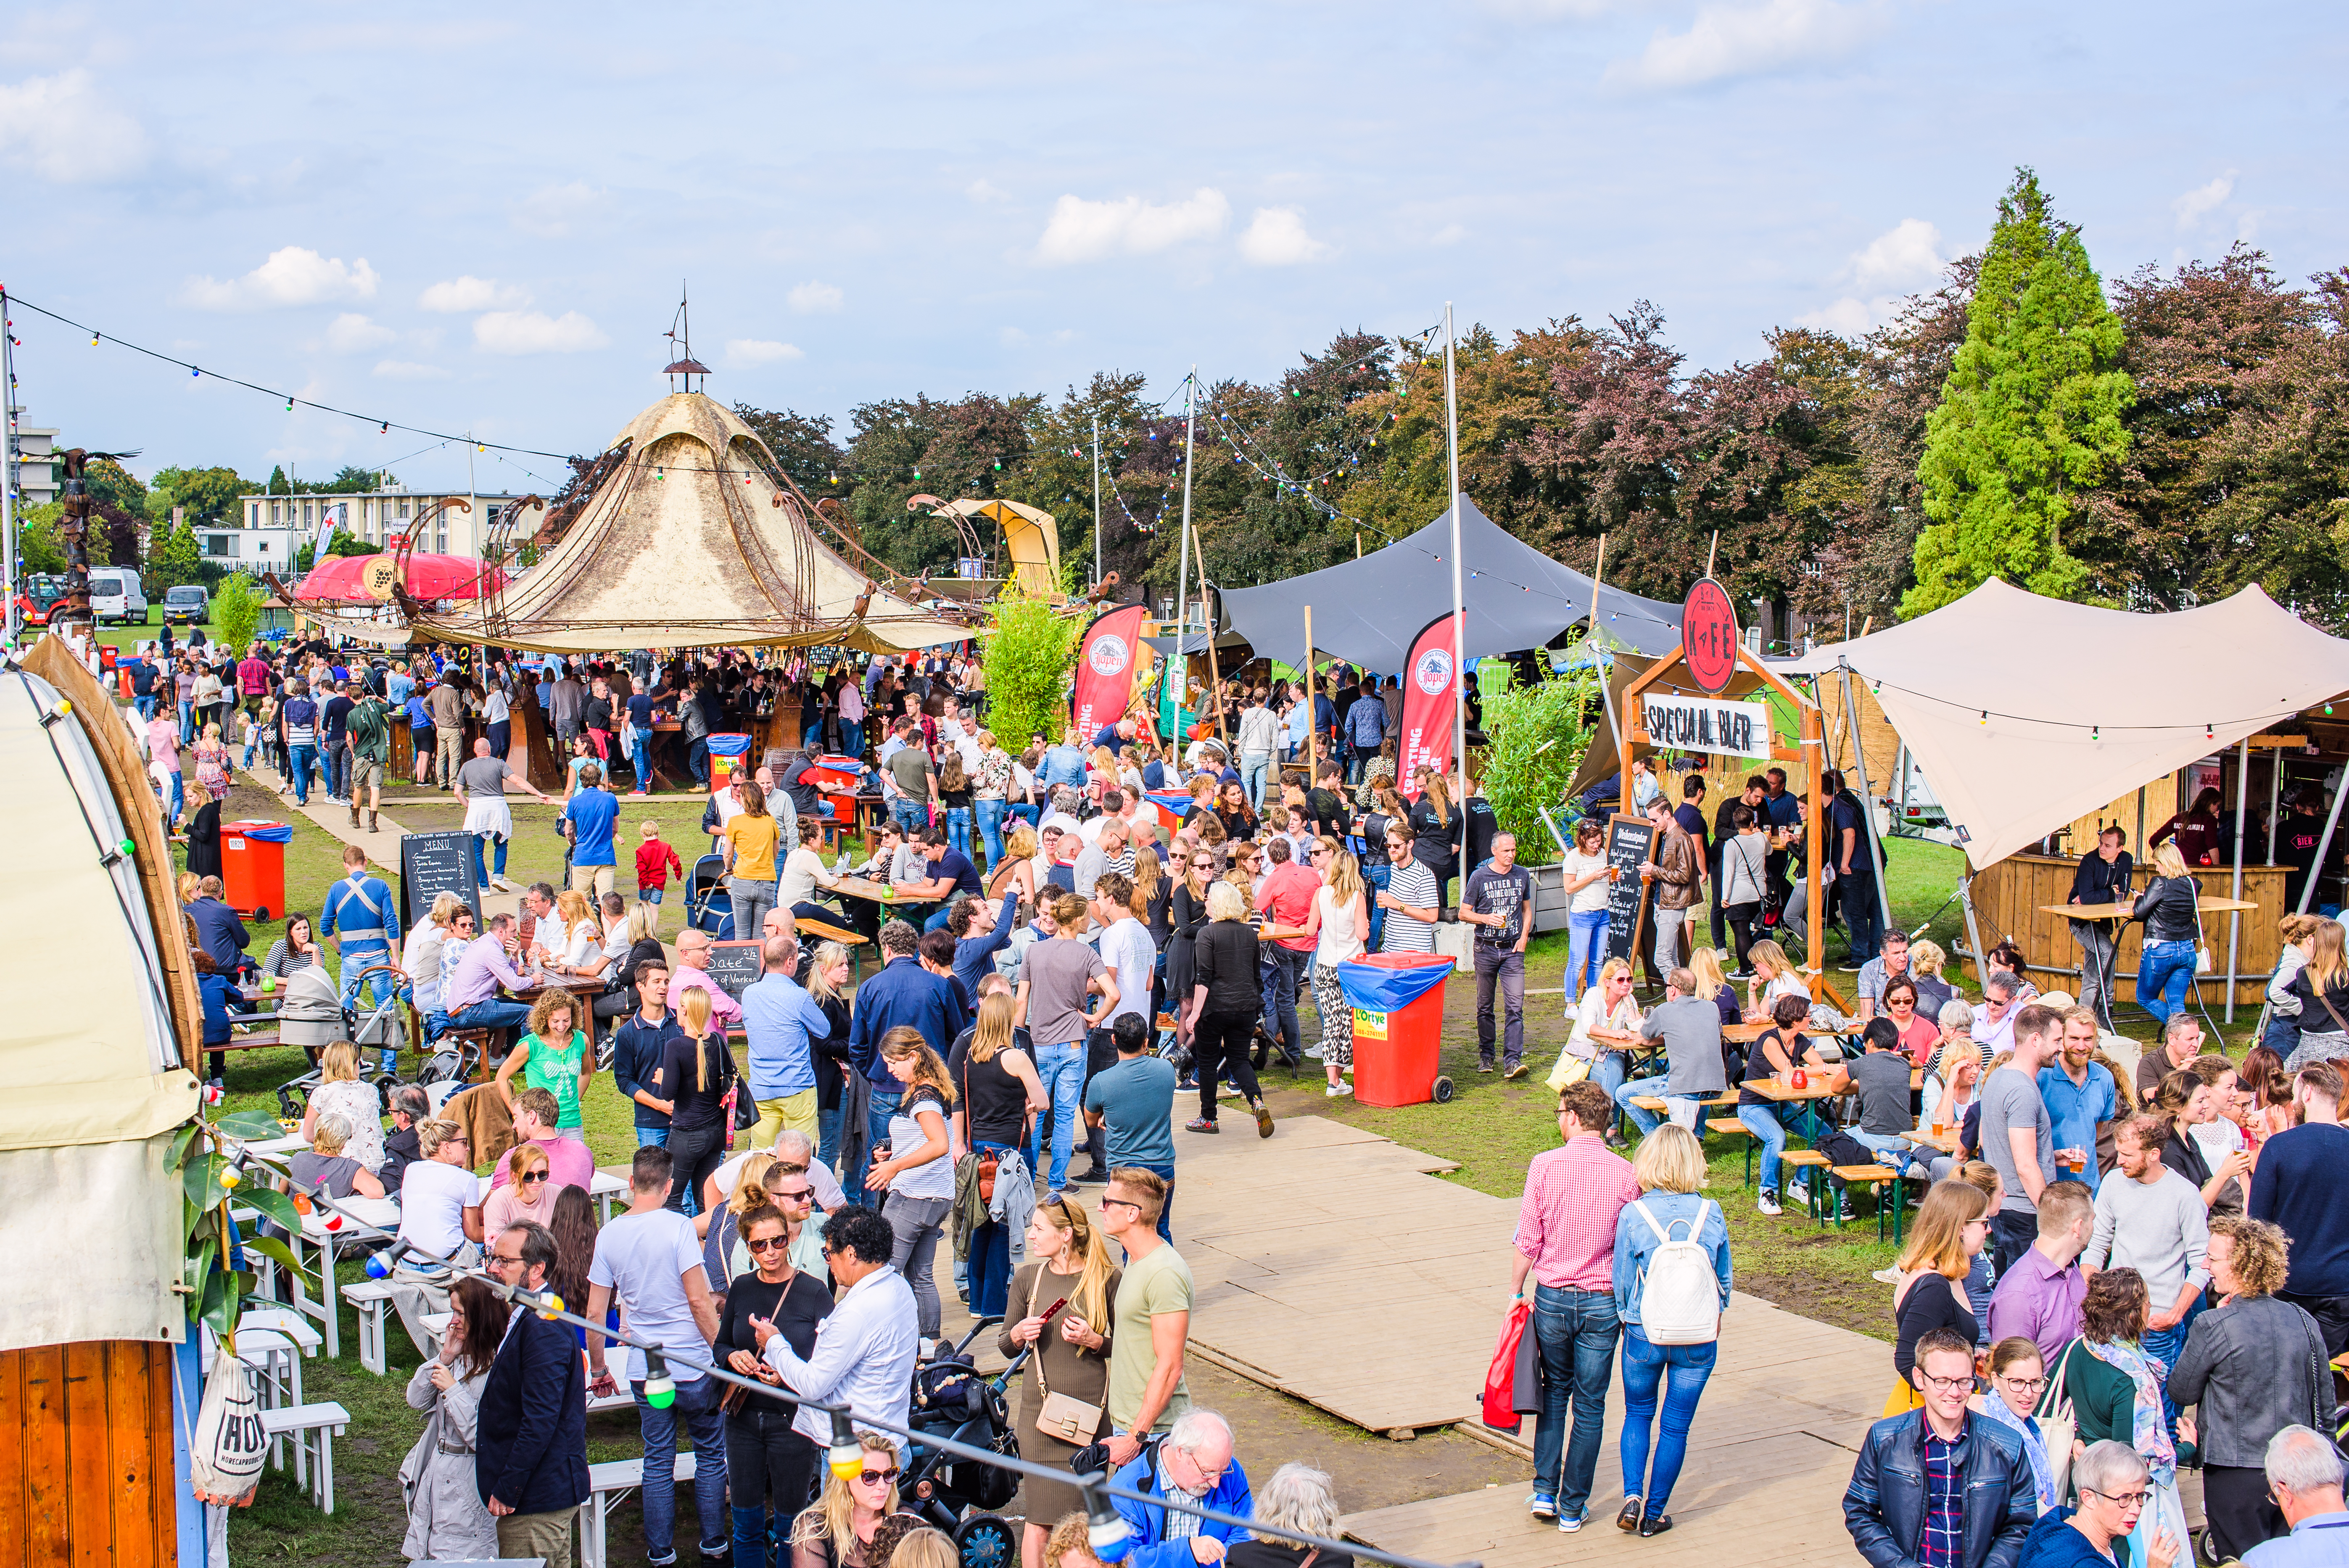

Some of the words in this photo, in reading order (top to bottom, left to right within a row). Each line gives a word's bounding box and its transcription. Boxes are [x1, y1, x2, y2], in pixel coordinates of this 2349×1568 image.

[1688, 614, 1731, 660] KAFÉ
[1093, 638, 1108, 651] CRAFTING
[1092, 652, 1122, 668] Jopen
[1420, 653, 1434, 668] CRAFTING
[1649, 705, 1713, 746] SPECIAAL
[1717, 710, 1750, 751] BIER
[1403, 728, 1422, 794] CRAFTING
[1617, 828, 1647, 844] Weihenstephan
[2297, 837, 2312, 846] BIER
[424, 839, 449, 850] MENU
[918, 858, 928, 871] Yo
[1483, 879, 1510, 891] RATHER
[1515, 879, 1522, 887] BE
[1486, 888, 1522, 899] SOMEONE'S
[1493, 898, 1508, 906] SHOT
[1510, 896, 1518, 905] OF
[1498, 929, 1507, 937] OF
[721, 975, 728, 985] of
[730, 973, 757, 984] Varken
[1356, 1009, 1385, 1025] L'Ortye
[1356, 1029, 1385, 1038] 088-3741111
